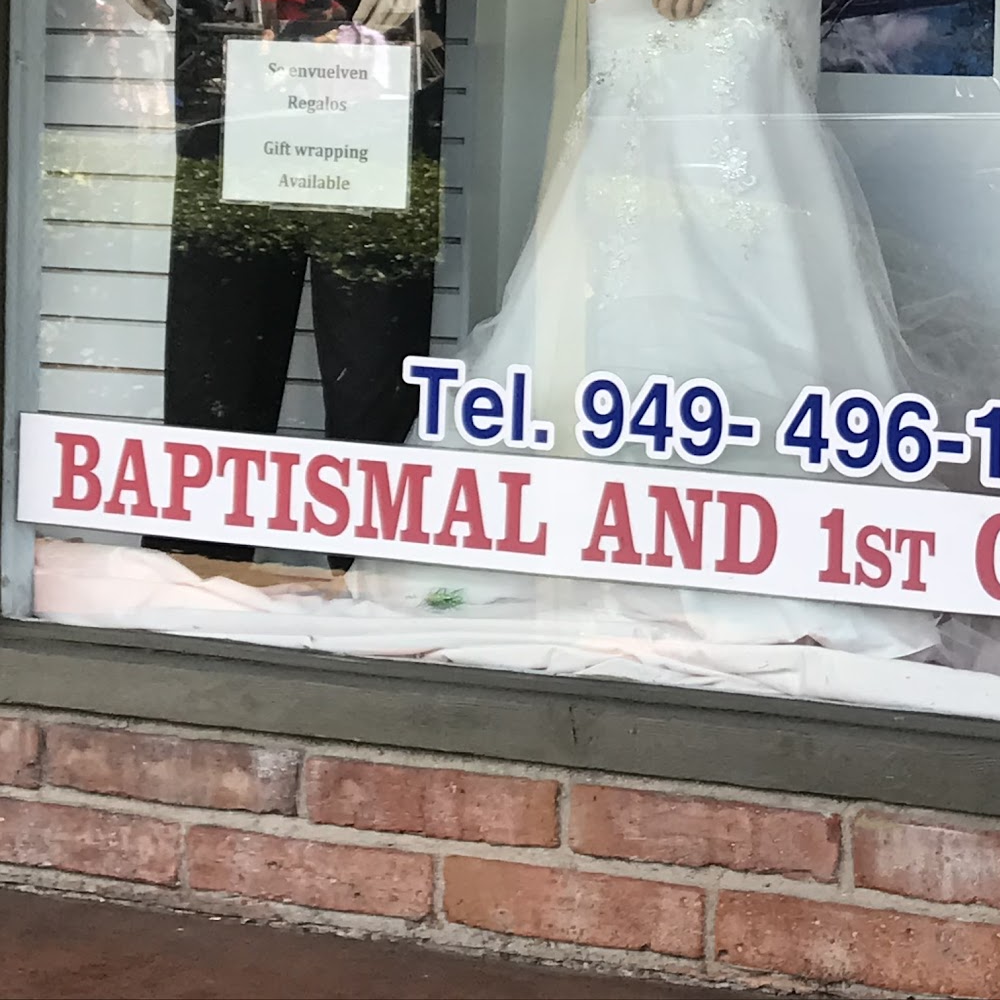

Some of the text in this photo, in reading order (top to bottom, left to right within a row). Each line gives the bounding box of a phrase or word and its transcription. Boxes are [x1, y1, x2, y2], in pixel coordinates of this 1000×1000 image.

[289, 64, 369, 80] envuelven
[288, 95, 347, 114] Regalos
[263, 141, 369, 163] Gift wrapping
[278, 173, 351, 191] Available
[409, 363, 549, 444] Tel.
[582, 377, 754, 458] 949-
[53, 431, 548, 556] BAPTISMAL
[581, 480, 779, 576] AND
[819, 508, 937, 592] 1ST
